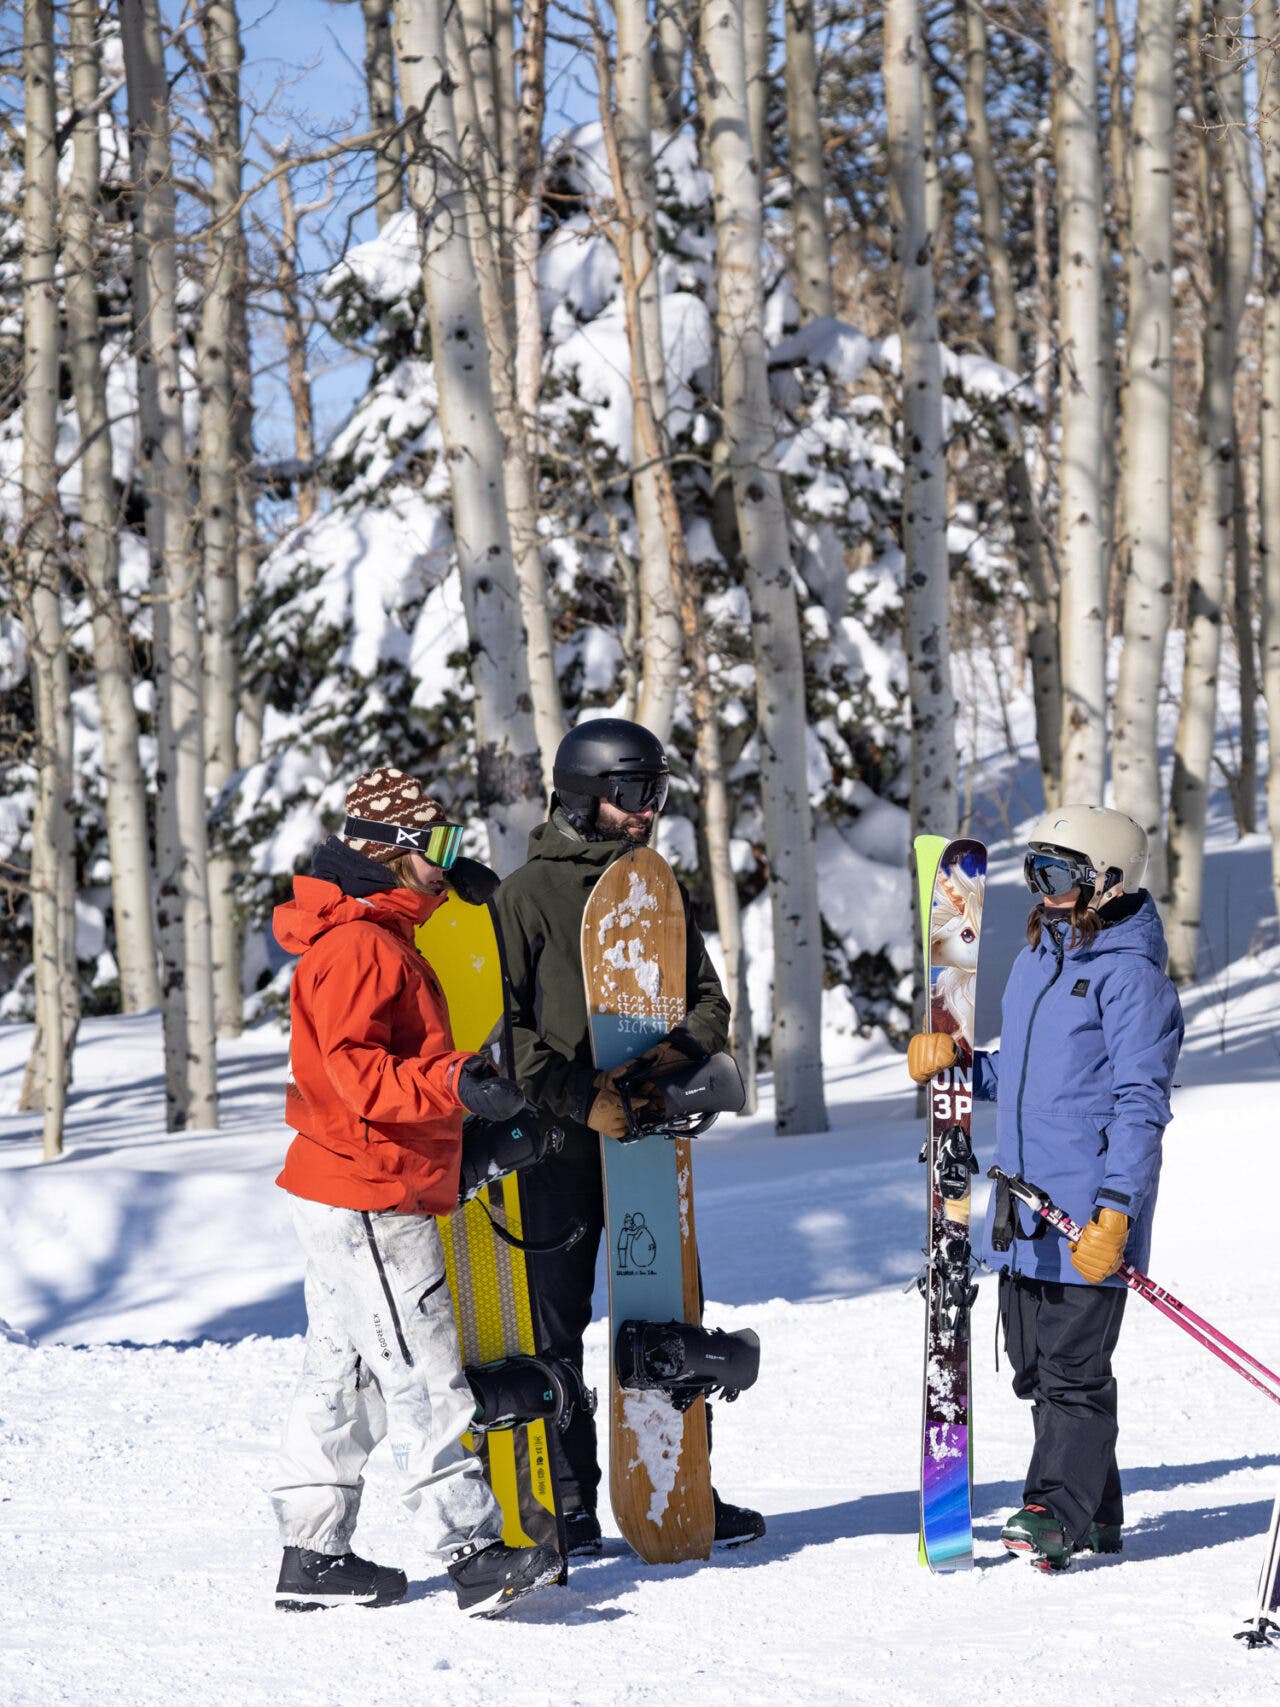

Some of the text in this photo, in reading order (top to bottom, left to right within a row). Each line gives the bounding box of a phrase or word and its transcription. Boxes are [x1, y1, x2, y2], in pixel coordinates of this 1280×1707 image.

[617, 1020, 679, 1034] SICK STIC
[933, 1093, 972, 1120] 3P
